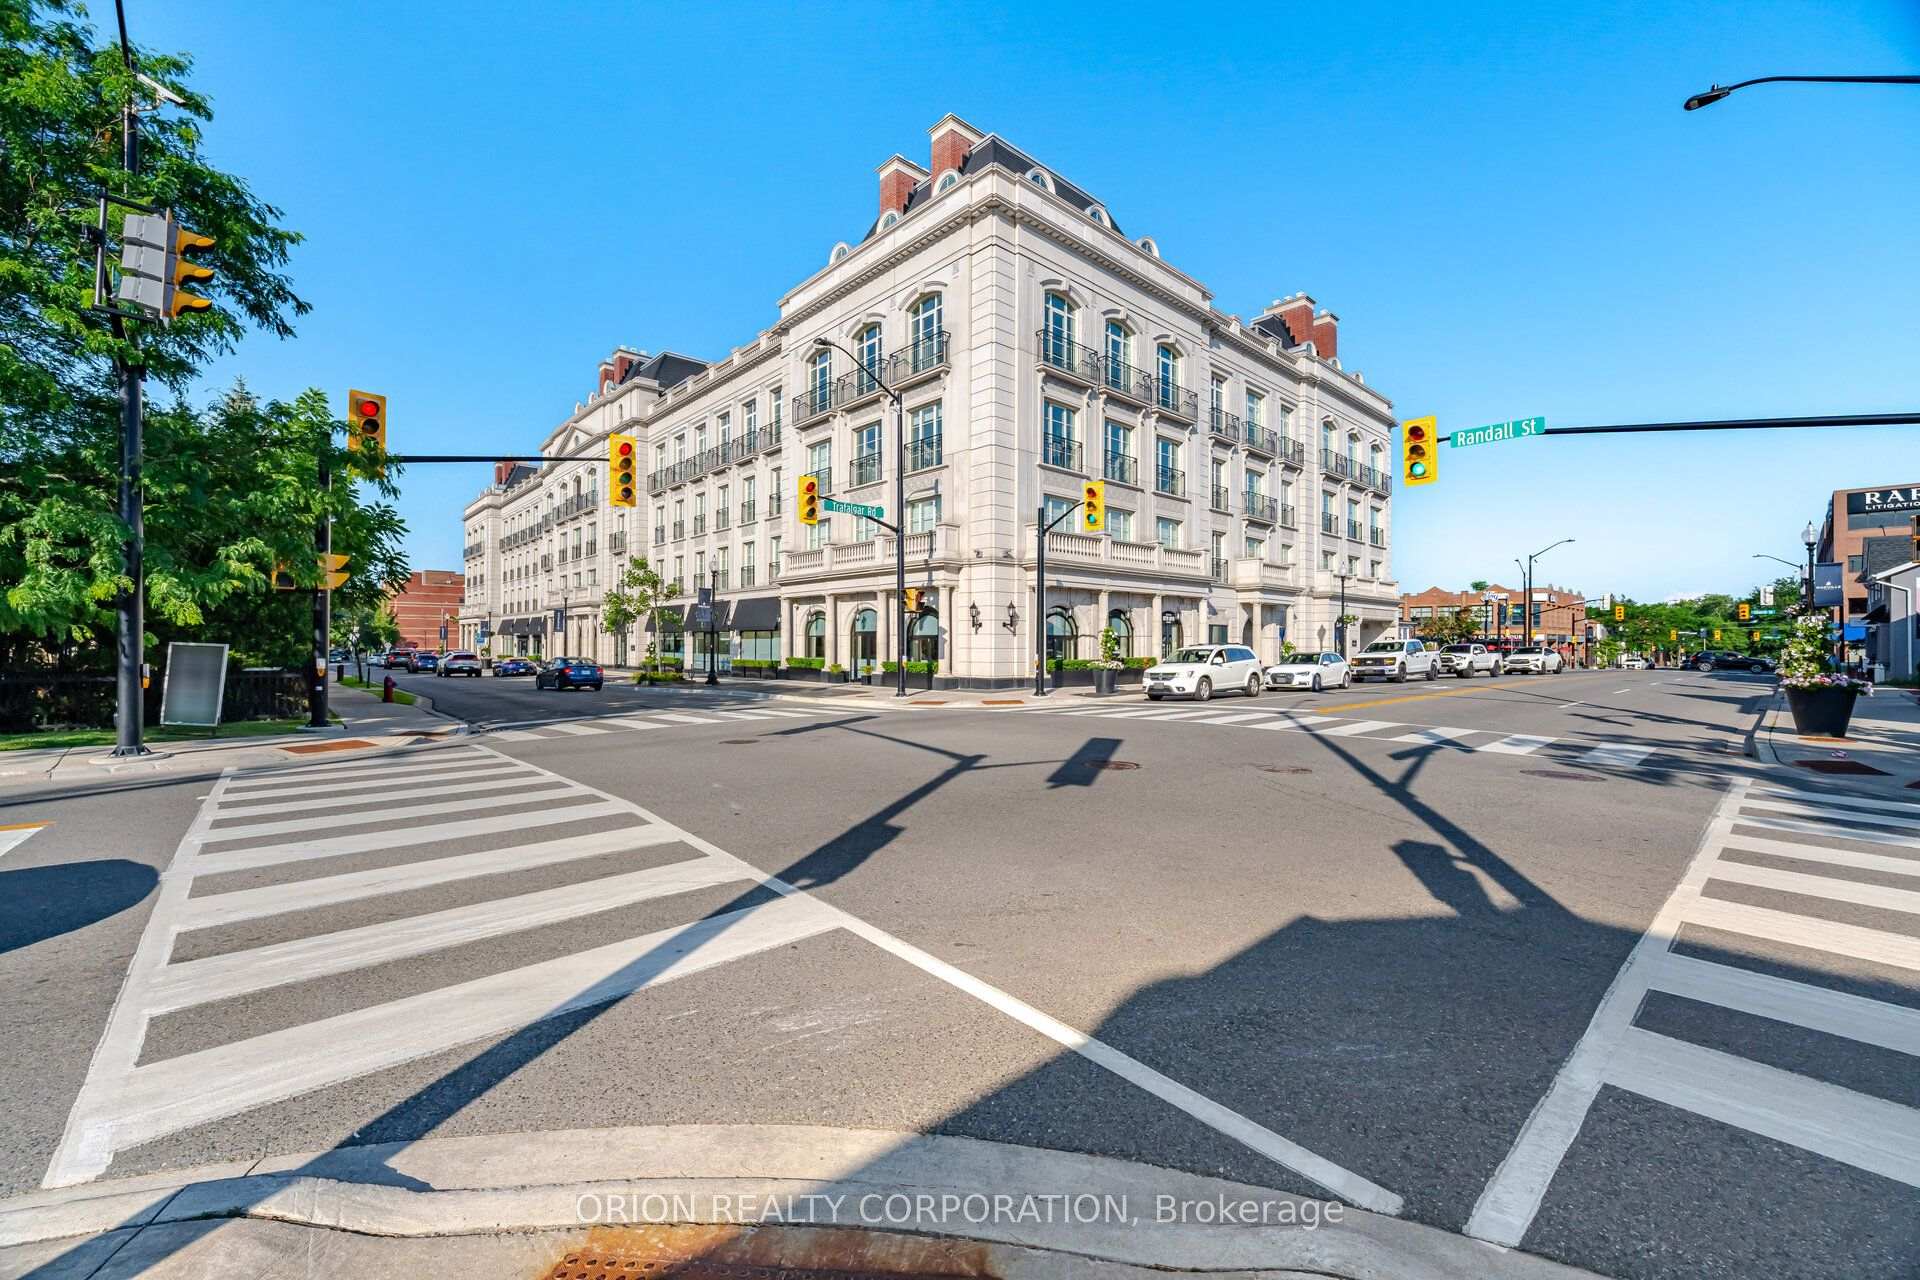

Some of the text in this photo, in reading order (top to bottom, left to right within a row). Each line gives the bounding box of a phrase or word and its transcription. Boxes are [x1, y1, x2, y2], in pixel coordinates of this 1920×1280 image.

[1457, 418, 1537, 446] Randall St
[833, 502, 877, 517] Trafalgar Rd
